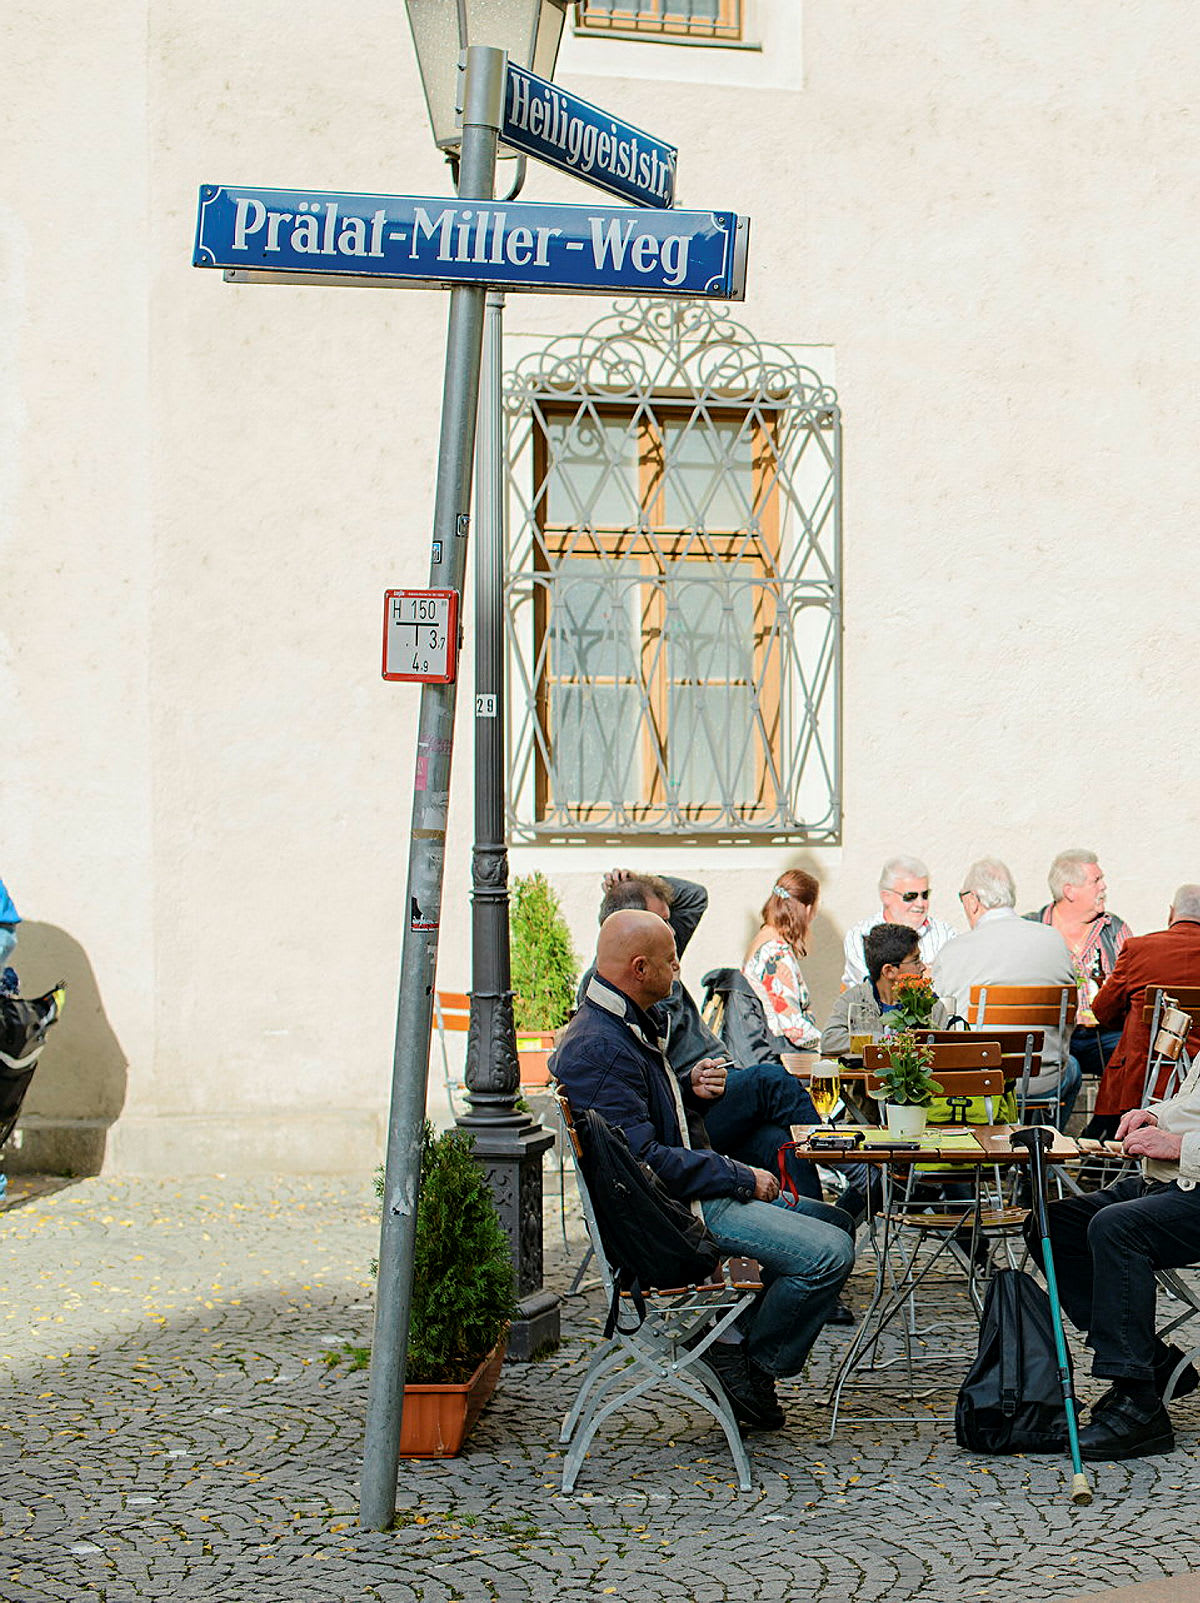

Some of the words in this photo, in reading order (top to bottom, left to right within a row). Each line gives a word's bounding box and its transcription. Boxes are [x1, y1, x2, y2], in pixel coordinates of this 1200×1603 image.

[231, 197, 693, 285] Prälat-Miller-Weg
[393, 599, 402, 618] H
[411, 600, 436, 620] 150
